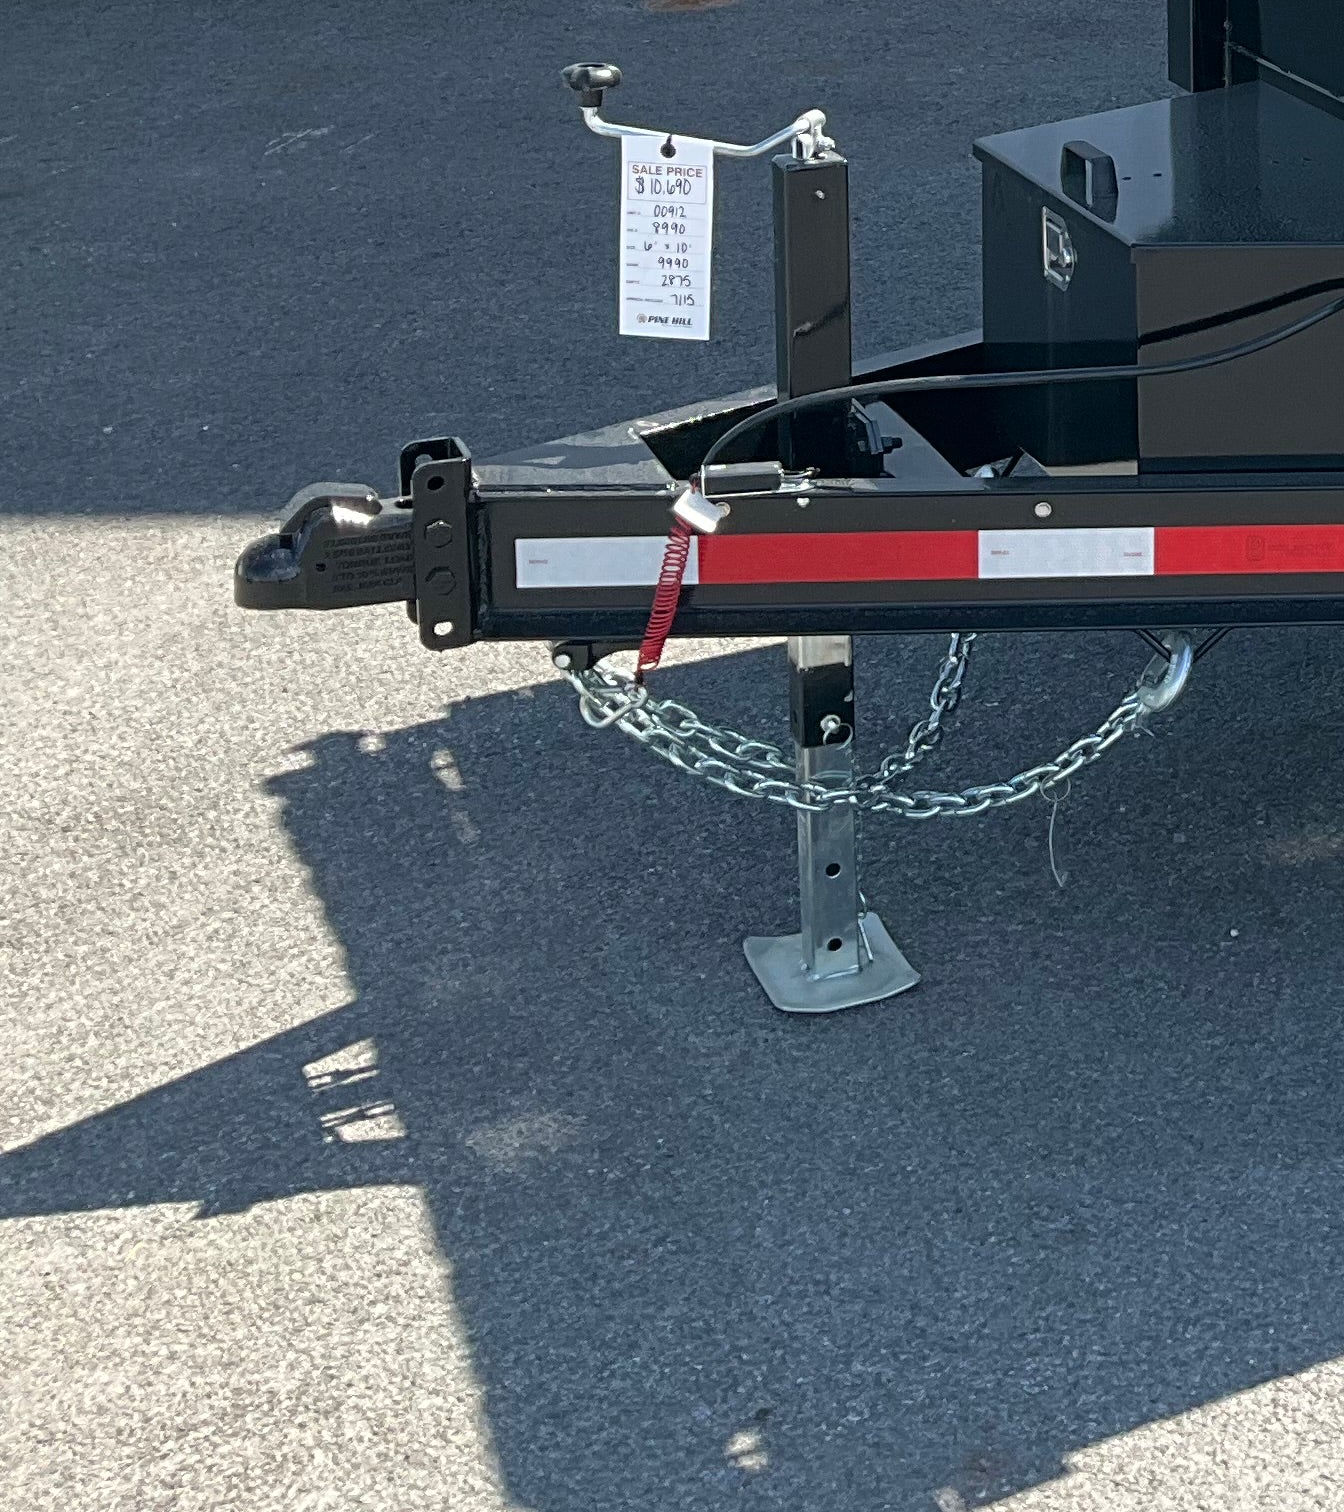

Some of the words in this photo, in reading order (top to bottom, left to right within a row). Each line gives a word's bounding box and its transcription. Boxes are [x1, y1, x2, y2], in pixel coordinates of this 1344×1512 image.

[632, 164, 663, 176] SALE
[666, 166, 703, 178] PRICE
[654, 205, 687, 218] 00912
[652, 221, 686, 235] 8990
[658, 256, 689, 269] 9990
[661, 274, 692, 287] 2875
[670, 293, 695, 307] 7115
[648, 315, 669, 324] PINE
[671, 316, 693, 326] HILL
